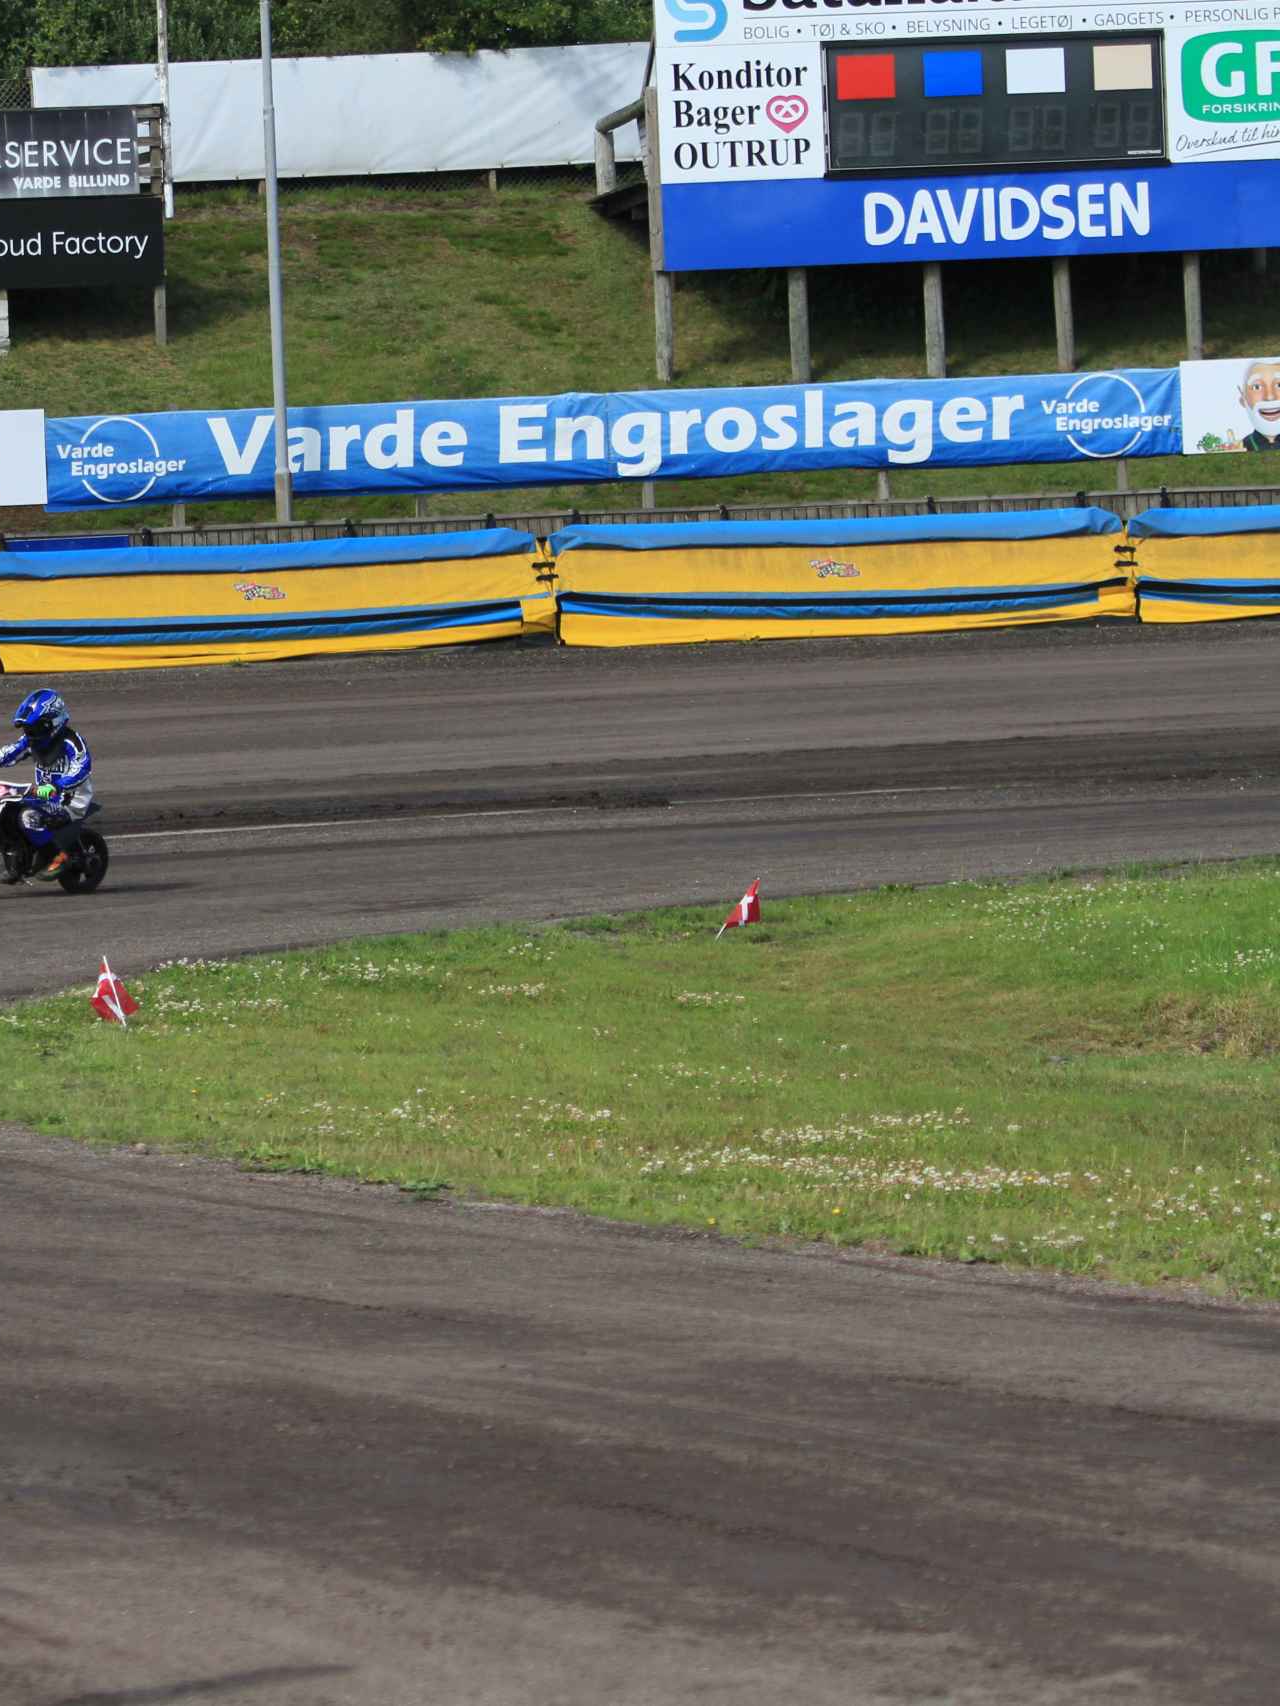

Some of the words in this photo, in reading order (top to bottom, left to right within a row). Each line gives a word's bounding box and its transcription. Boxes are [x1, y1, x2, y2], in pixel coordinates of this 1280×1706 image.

[743, 25, 790, 40] BOLIG
[810, 23, 835, 39] TØJ
[840, 23, 851, 36] &
[855, 22, 886, 36] SKO
[907, 18, 991, 34] BELYSNING
[1011, 15, 1073, 30] LEGETØJ
[1094, 11, 1164, 27] GADGETS
[1185, 7, 1269, 23] PERSONLIG
[672, 60, 808, 92] Konditor
[673, 99, 761, 135] Bager
[673, 138, 811, 170] OUTRUP
[13, 175, 62, 190] VARDE
[68, 173, 131, 188] BILLUND
[864, 181, 1151, 246] DAVIDSEN
[52, 231, 150, 260] Factory
[1041, 398, 1100, 415] Varde
[207, 409, 468, 476] Varde
[498, 389, 1025, 478] Engroslager
[1056, 413, 1172, 434] Engroslager
[56, 442, 115, 460] Varde
[71, 458, 187, 480] Engroslager
